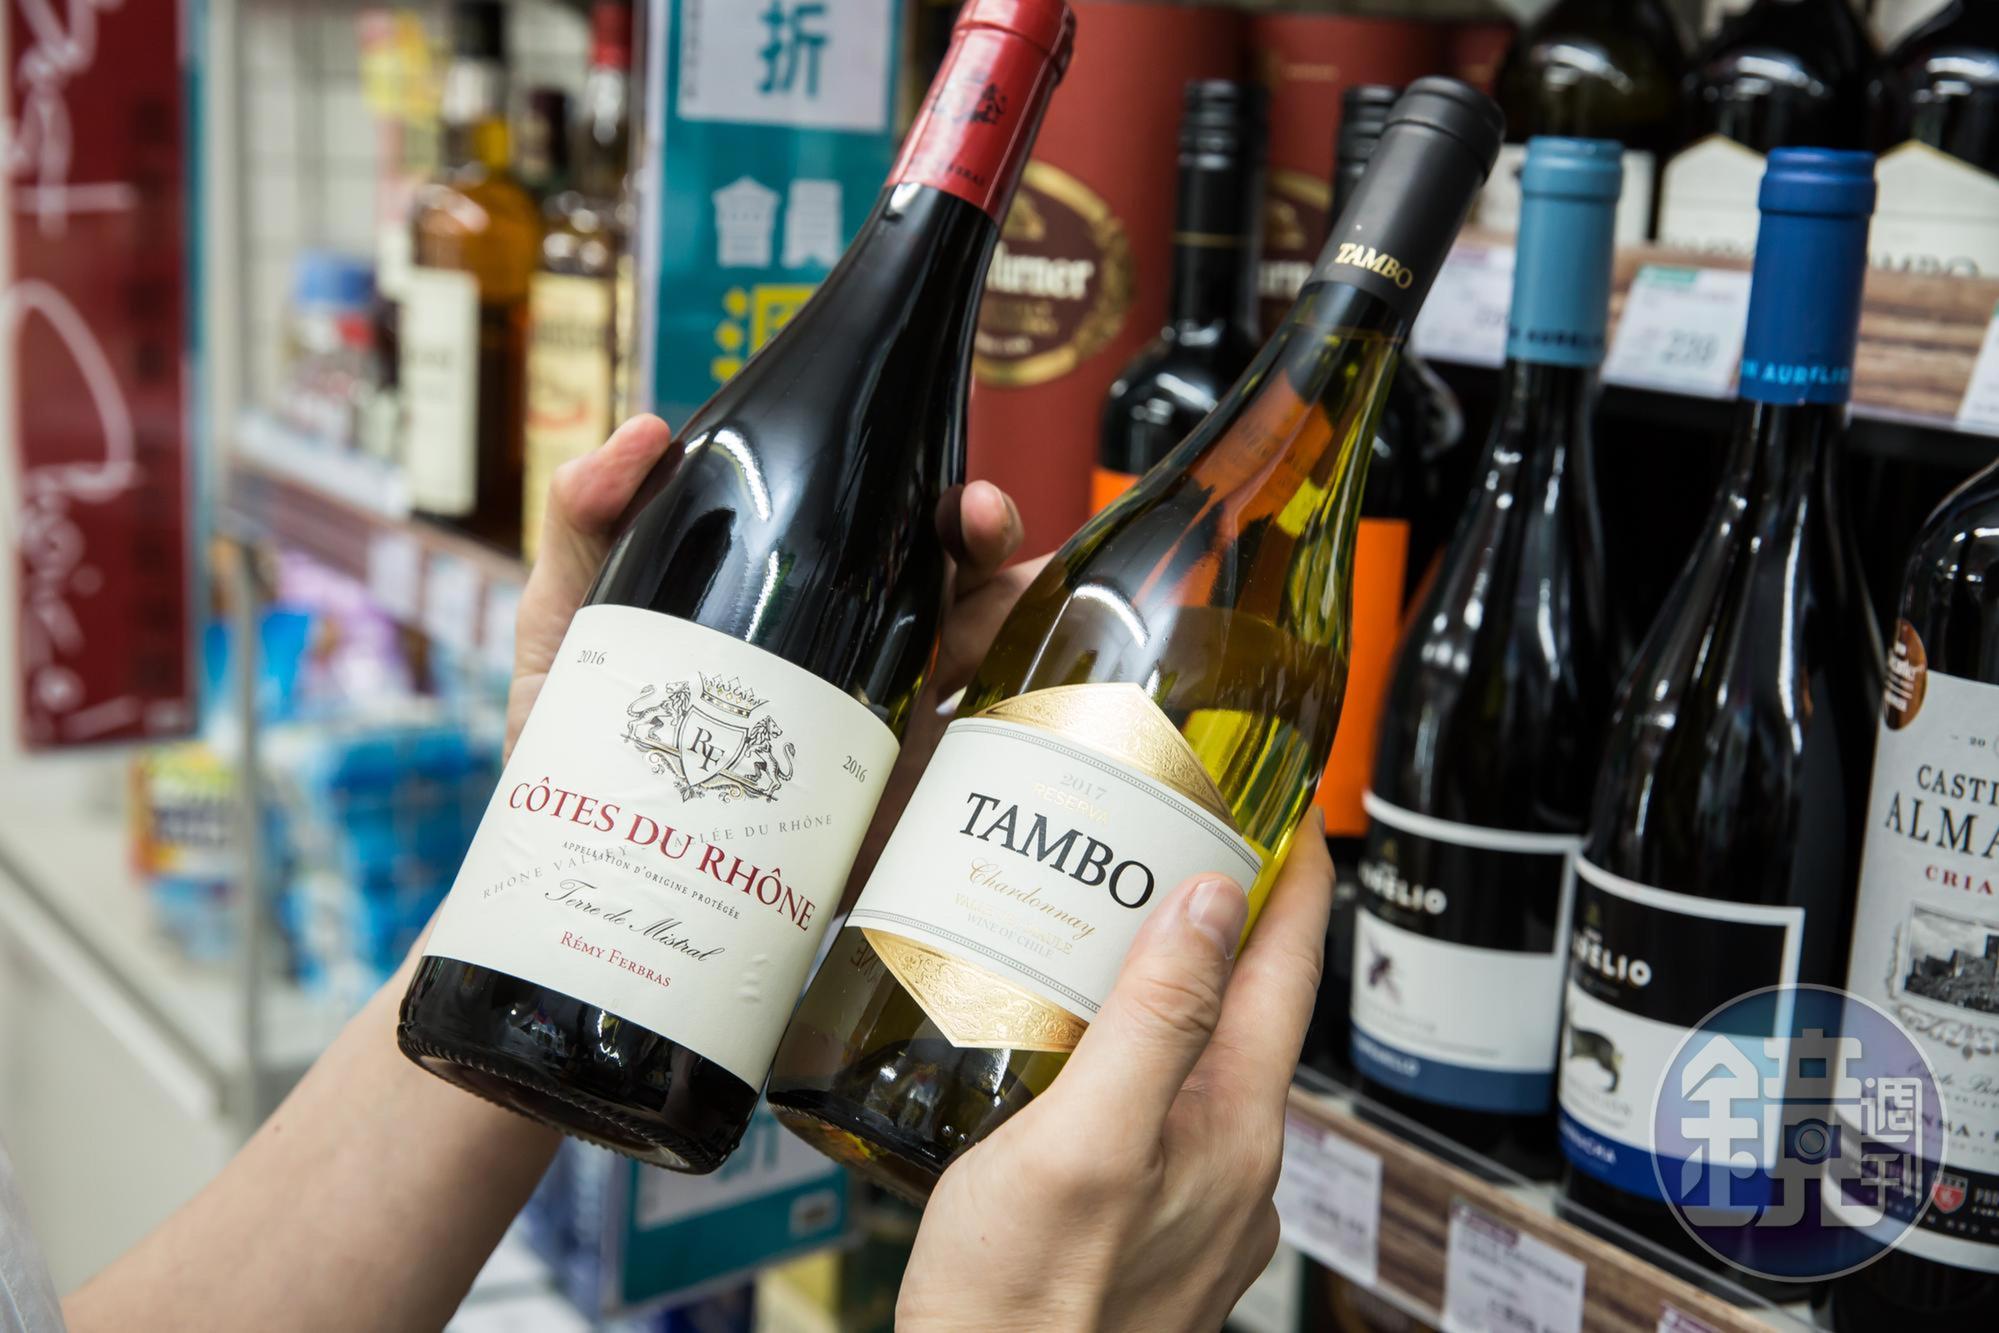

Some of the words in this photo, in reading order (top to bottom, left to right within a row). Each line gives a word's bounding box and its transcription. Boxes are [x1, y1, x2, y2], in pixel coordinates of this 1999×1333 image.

[757, 0, 829, 98] 折
[711, 174, 843, 269] 會員
[1334, 242, 1413, 289] TAMBO
[577, 649, 608, 665] 2016
[843, 754, 869, 783] 2016
[1060, 772, 1108, 800] 2017
[745, 824, 770, 838] DU
[779, 814, 833, 833] RHÔNE
[1032, 782, 1110, 826] RESERVA
[509, 776, 622, 832] CÔTES
[624, 813, 695, 860] DU
[696, 843, 817, 931] RHÔNE
[959, 792, 1155, 909] TAMBO
[482, 866, 544, 900] RHONE
[562, 841, 632, 871] APPELLATION
[691, 890, 740, 920] PROTÉGÉE
[968, 857, 1096, 941] Chardonnay
[544, 878, 601, 915] Terre
[602, 909, 633, 925] de
[629, 918, 726, 961] Mistral
[966, 912, 996, 933] WINE
[999, 927, 1017, 941] OF
[1016, 933, 1055, 957] CHILE
[560, 931, 606, 959] RÉMY
[607, 948, 672, 987] FERBRAS
